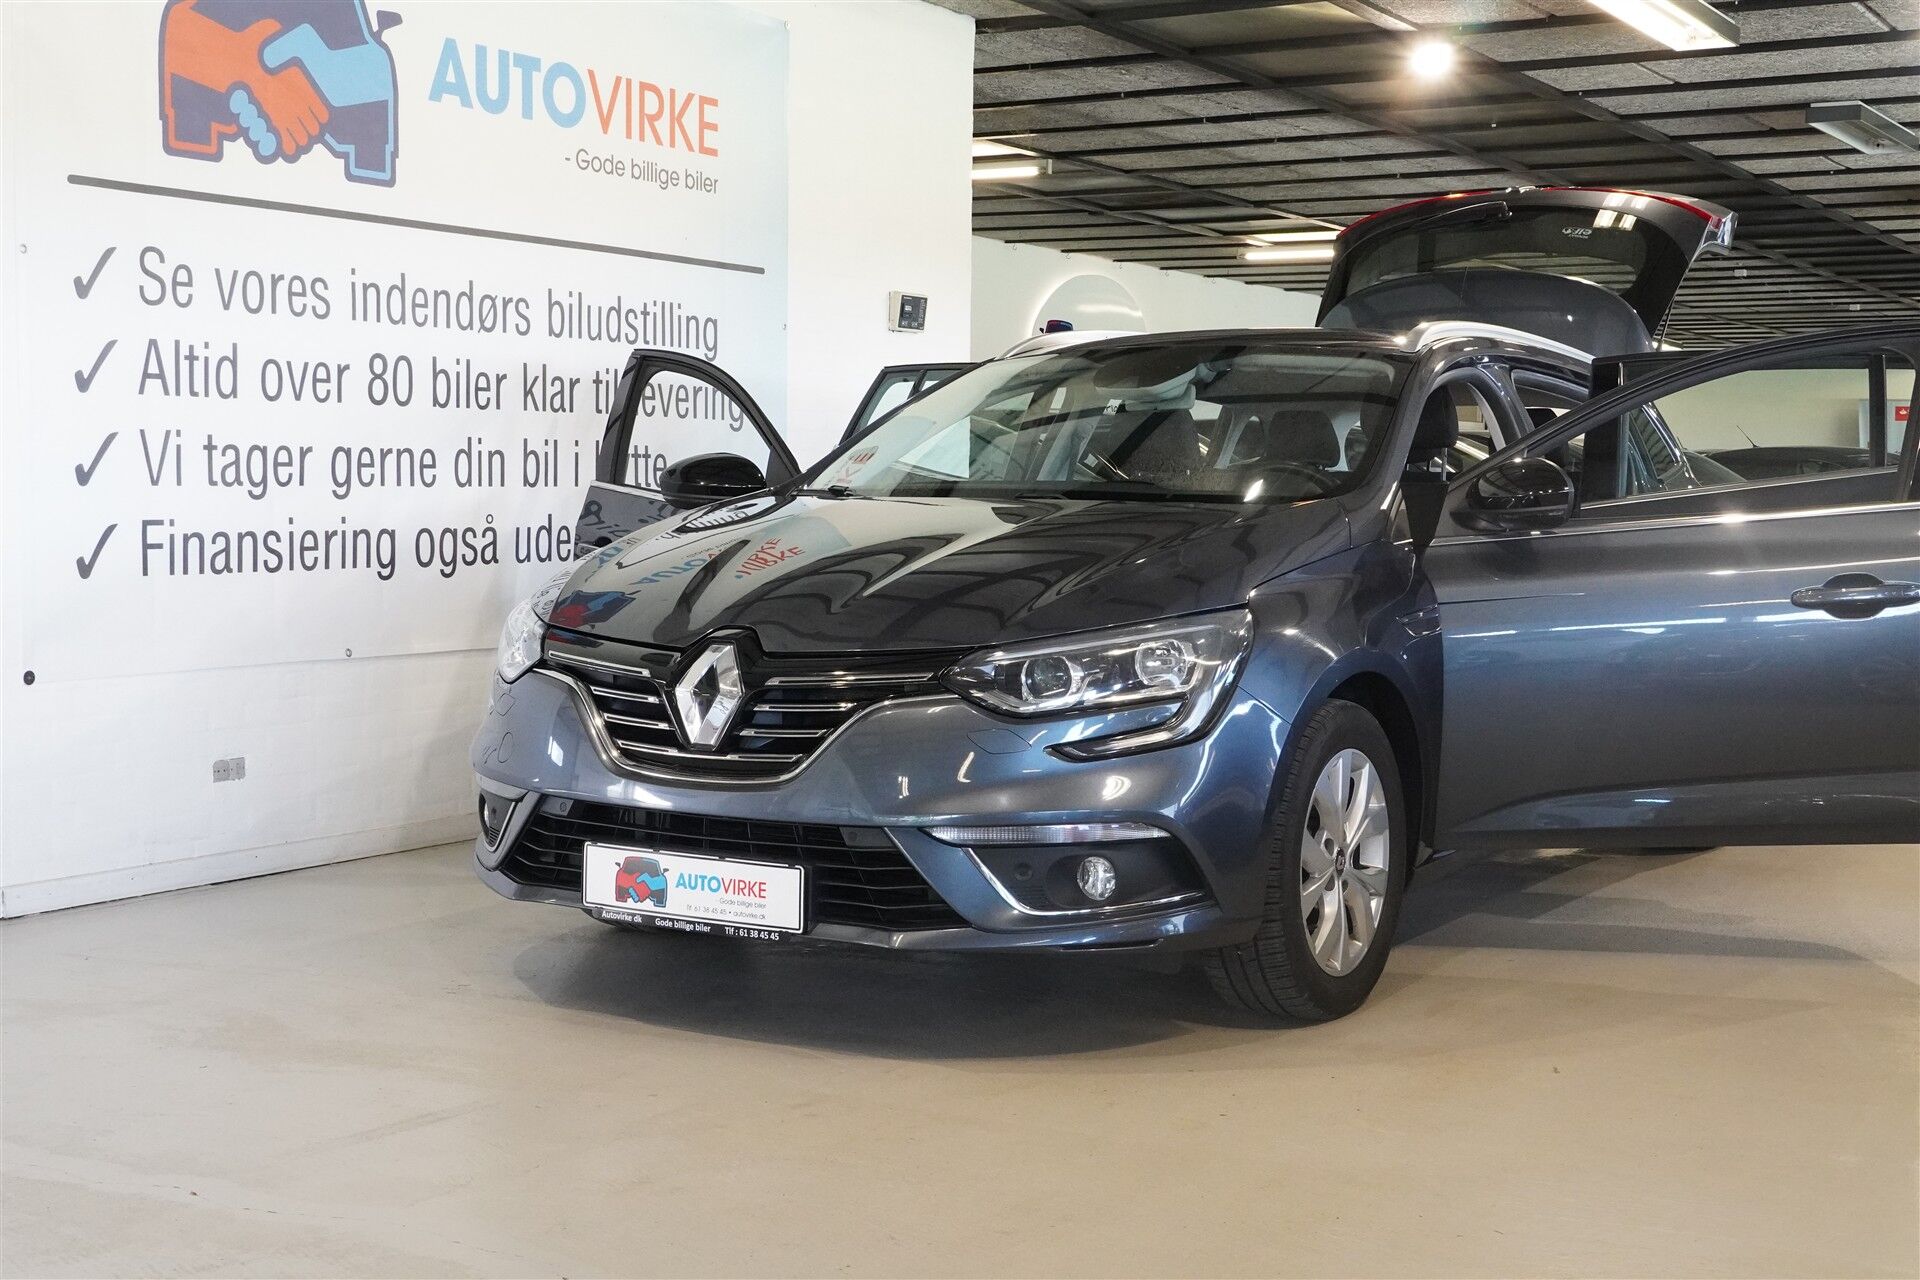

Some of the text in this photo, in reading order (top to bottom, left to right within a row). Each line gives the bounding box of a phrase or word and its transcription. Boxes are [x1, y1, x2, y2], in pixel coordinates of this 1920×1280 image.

[428, 36, 719, 157] AUTOVIRKE
[575, 148, 626, 177] Gode
[630, 158, 680, 191] billige
[684, 169, 719, 194] biler
[138, 245, 718, 362] Se vores indendørs biludstilling
[138, 338, 238, 400] Altid
[260, 358, 351, 404] over
[367, 352, 414, 407] 80
[432, 356, 508, 411] biler
[522, 362, 581, 414] klar
[637, 380, 744, 433] evering
[139, 429, 182, 487] Vi
[202, 434, 313, 501] tager
[331, 445, 437, 501] gerne
[454, 437, 505, 489] din
[523, 438, 558, 489] bil
[574, 440, 580, 487] i
[141, 514, 577, 581] Finansiering også ude
[675, 872, 767, 899] AUTOVIRKE
[601, 910, 632, 922] Autovirke
[655, 918, 673, 928] Gode
[674, 920, 694, 931] billige
[695, 923, 711, 933] biler
[740, 929, 748, 937] 61
[750, 930, 759, 938] 38
[760, 931, 769, 940] 45
[770, 932, 780, 941] 45
